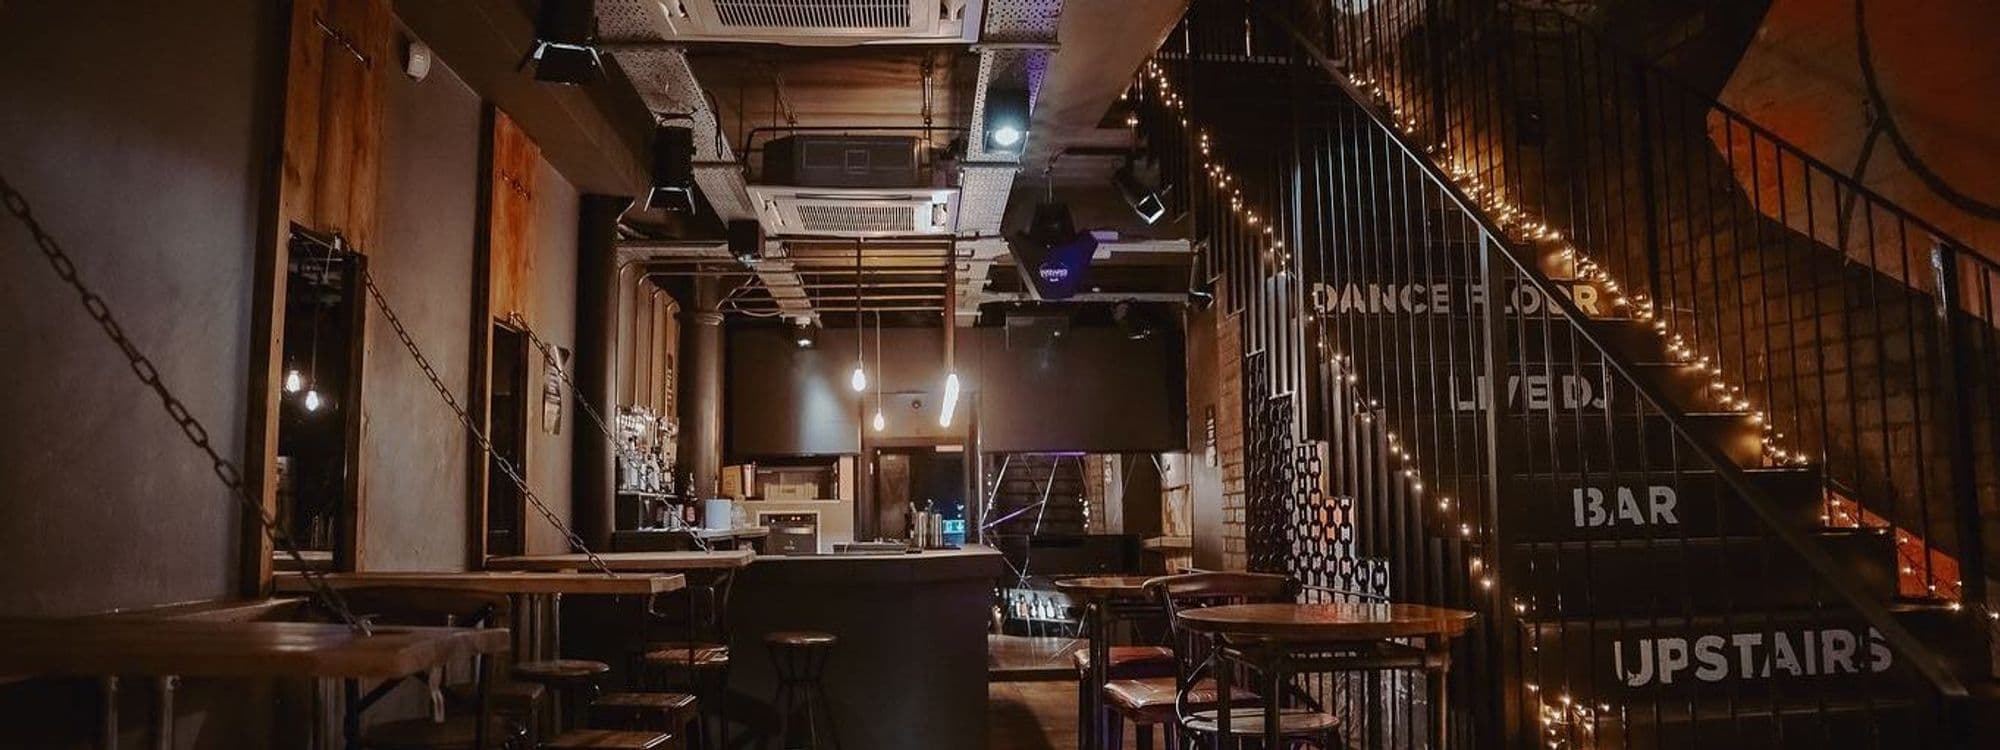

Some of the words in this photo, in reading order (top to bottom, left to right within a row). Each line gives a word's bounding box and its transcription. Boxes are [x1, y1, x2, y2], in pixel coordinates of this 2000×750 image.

[1312, 283, 1450, 314] DANCE
[1573, 485, 1681, 527] BAR
[1613, 626, 1893, 688] UPSTAIRS
